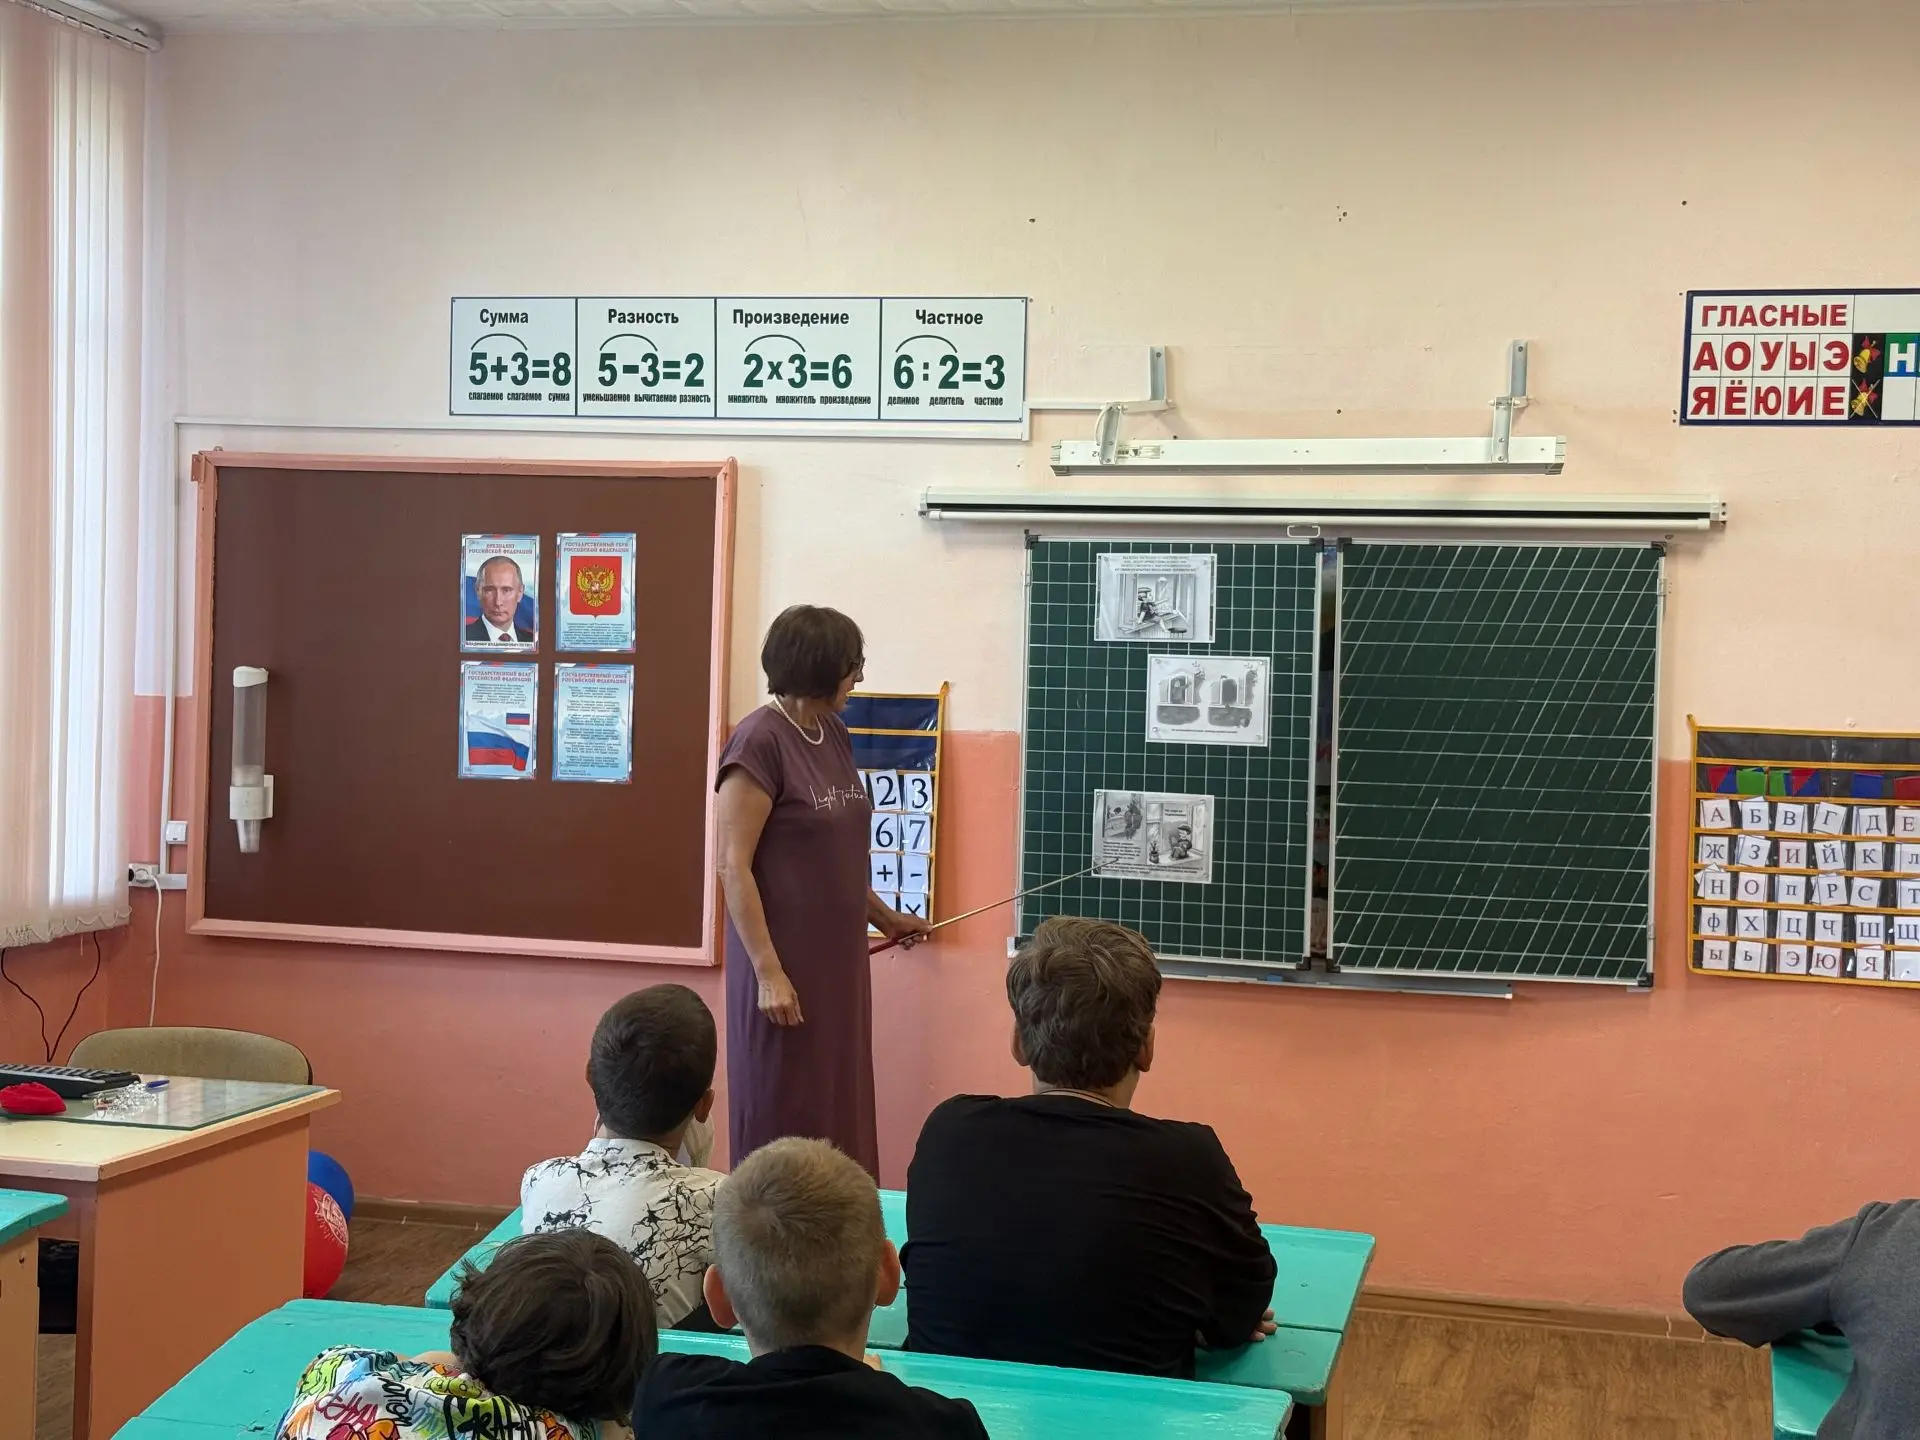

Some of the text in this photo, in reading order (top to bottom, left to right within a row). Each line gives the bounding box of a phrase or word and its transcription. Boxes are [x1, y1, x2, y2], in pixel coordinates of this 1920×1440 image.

[479, 308, 529, 327] Сумма
[608, 308, 679, 324] Разность
[732, 309, 849, 328] Произведение
[915, 309, 984, 325] Частное
[1701, 304, 1847, 327] ГЛАСНЫЕ
[468, 352, 572, 386] 5+3=8
[468, 391, 570, 402] слагаемое слагаемое сумма
[582, 392, 711, 404] уменьшаемое вычитаемое разность
[727, 394, 872, 406] множитель множитель произведение
[887, 396, 1004, 407] делимое делитель частное
[876, 776, 928, 809] 2 3
[1710, 807, 1915, 833] А Б В Г Д Е
[875, 817, 926, 850] 6 7
[1705, 843, 1725, 859] Ж
[1784, 848, 1800, 863] И
[1822, 844, 1836, 863] Й
[1862, 849, 1877, 864] К
[1710, 880, 1724, 894] Н
[1744, 880, 1759, 895] О
[1827, 883, 1838, 899] Р
[1858, 885, 1873, 901] С
[1744, 916, 1759, 931] Х
[1785, 917, 1801, 940] Ц
[1822, 920, 1836, 936] Ч
[1859, 922, 1880, 938] Ш
[1786, 952, 1800, 966] Э
[1815, 953, 1837, 969] Ю
[1863, 957, 1877, 971] Я
